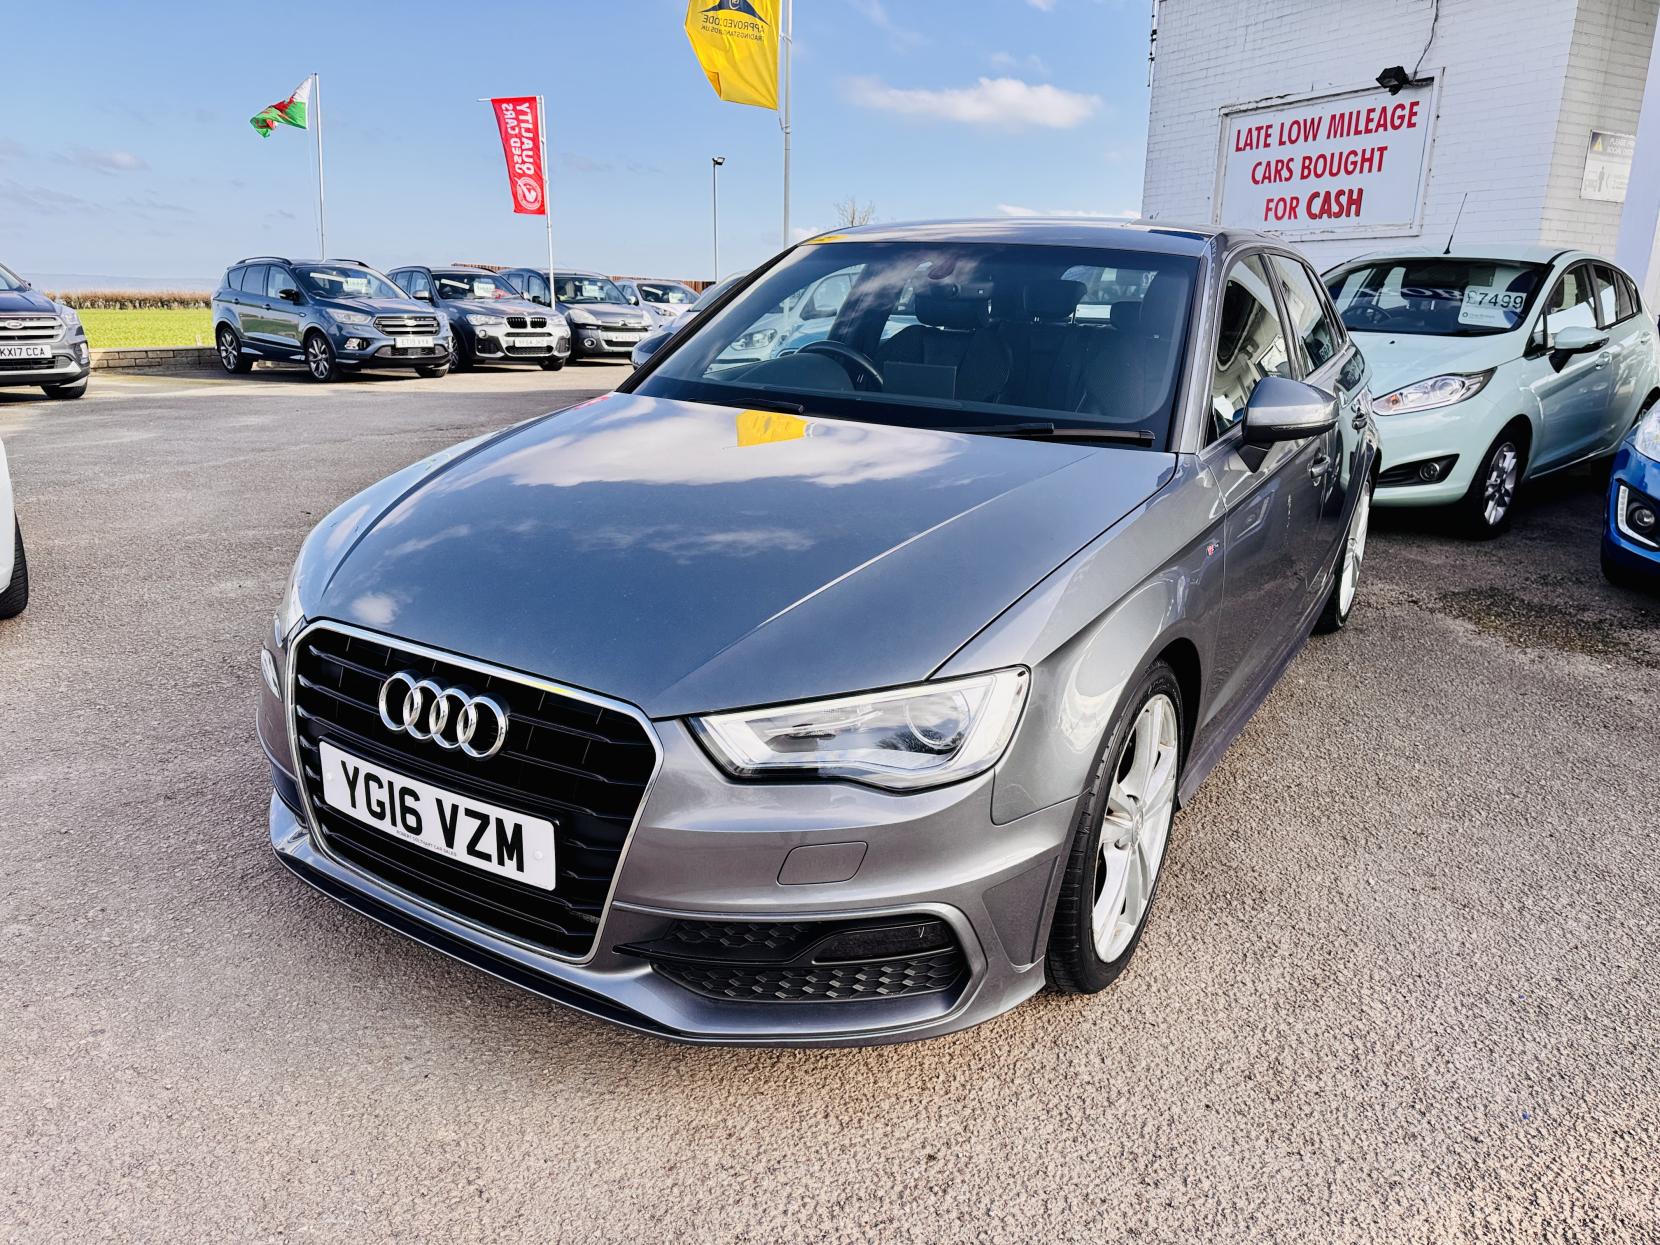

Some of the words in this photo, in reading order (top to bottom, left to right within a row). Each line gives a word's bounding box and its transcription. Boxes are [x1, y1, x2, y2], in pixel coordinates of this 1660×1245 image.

[1235, 124, 1273, 152] LATE
[1278, 116, 1322, 146] LOW
[1326, 101, 1420, 139] MILEAGE
[1251, 158, 1294, 185] CARS
[1300, 146, 1388, 180] BOUGHT
[1264, 196, 1300, 221] FOR
[1306, 188, 1363, 220] CASH
[1466, 290, 1524, 309] £7499
[0, 347, 23, 357] KX17
[26, 347, 45, 357] CCA
[341, 760, 423, 836] YG16
[435, 798, 525, 873] VZM
